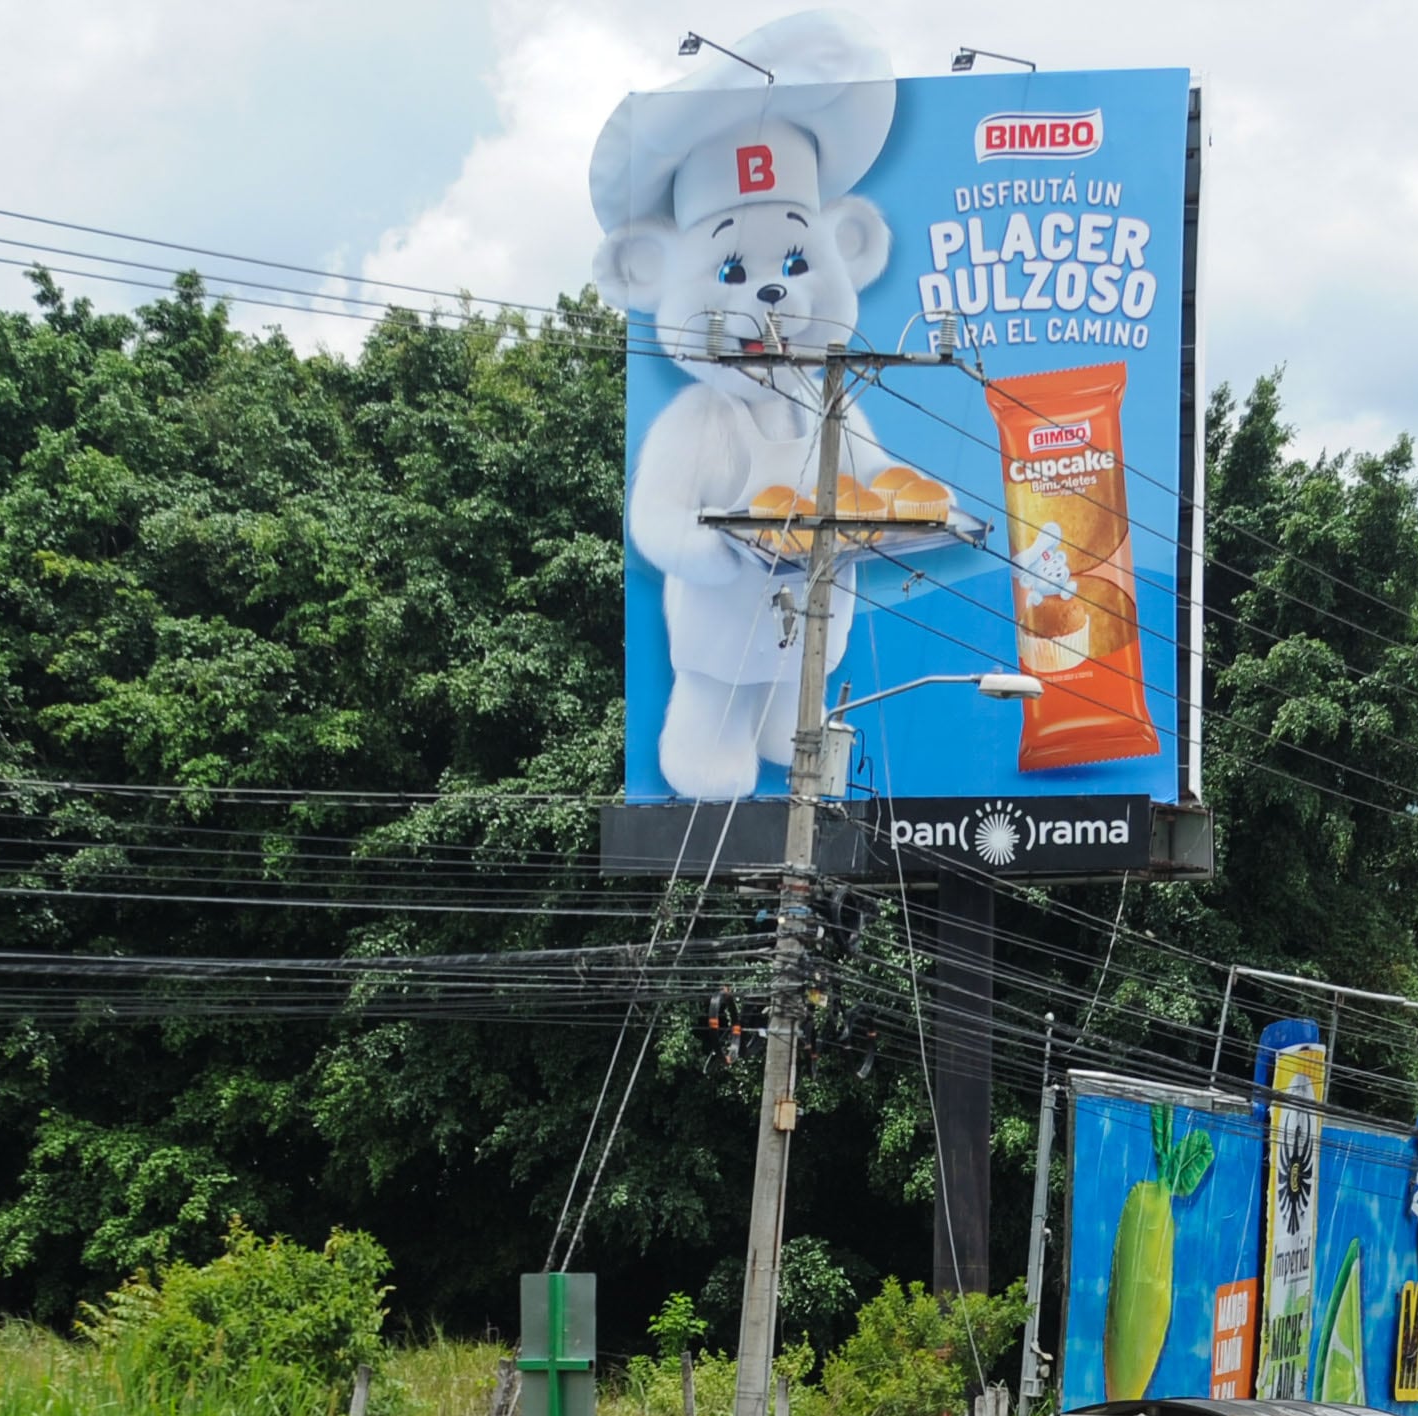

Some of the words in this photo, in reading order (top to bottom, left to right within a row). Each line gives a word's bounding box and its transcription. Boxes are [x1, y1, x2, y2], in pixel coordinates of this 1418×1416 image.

[985, 121, 1094, 150] BIMBO
[735, 144, 775, 195] B
[955, 171, 1078, 213] DISFRUTÁ
[1087, 179, 1122, 207] UN
[929, 212, 1151, 272] PLACER
[919, 260, 1157, 323] DULZOSO
[1007, 318, 1037, 344] EL
[1047, 318, 1149, 349] CAMINO
[1033, 427, 1086, 446] BIMBO
[1009, 449, 1115, 483] Cupcake
[1272, 1237, 1311, 1286] Imperial
[1216, 1289, 1249, 1333] MANGO
[1214, 1327, 1244, 1377] LIMÓN
[1271, 1312, 1303, 1362] MICHE
